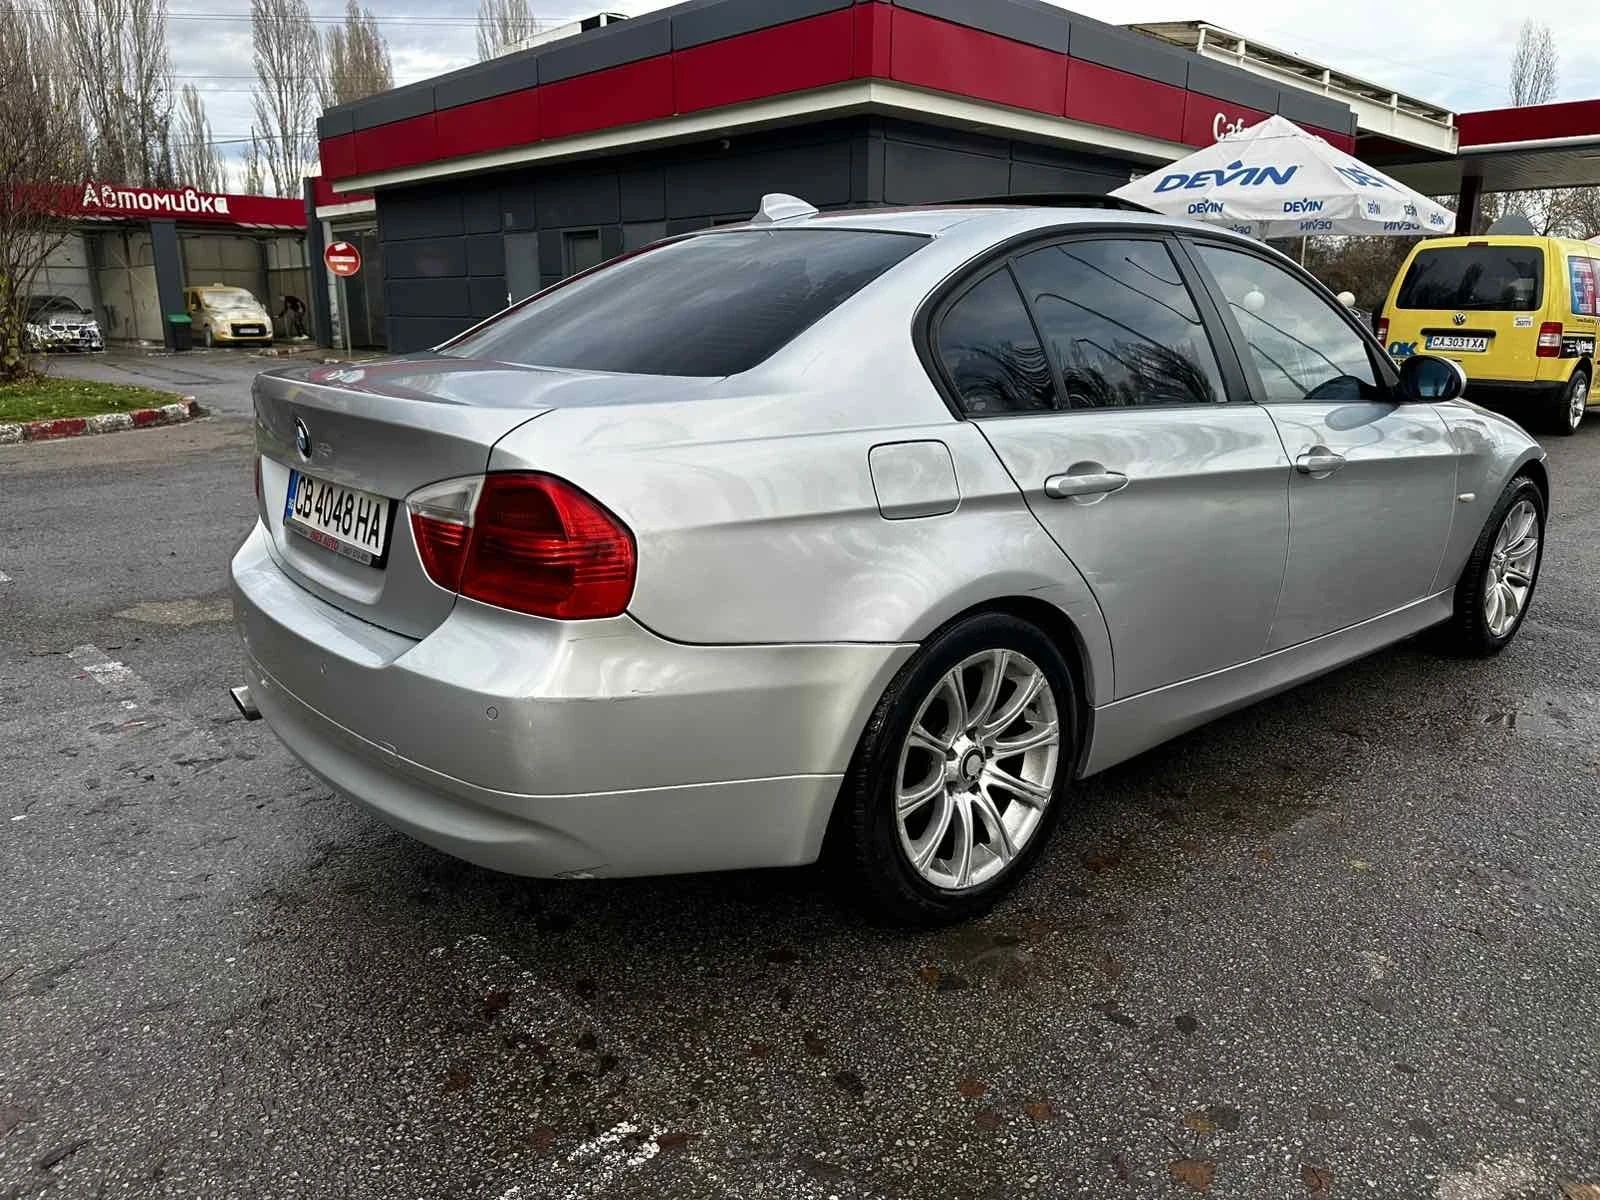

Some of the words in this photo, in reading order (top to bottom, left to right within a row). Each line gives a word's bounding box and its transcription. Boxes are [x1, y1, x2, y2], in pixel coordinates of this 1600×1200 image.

[1213, 113, 1249, 141] Caf
[1153, 160, 1298, 193] DEVIN
[82, 182, 230, 214] Автомивка
[1188, 199, 1225, 214] DEVIN
[1283, 198, 1323, 213] DEVIN
[1448, 337, 1470, 347] 3031
[295, 476, 314, 518] CB
[315, 484, 354, 535] 4048
[354, 497, 380, 548] HA
